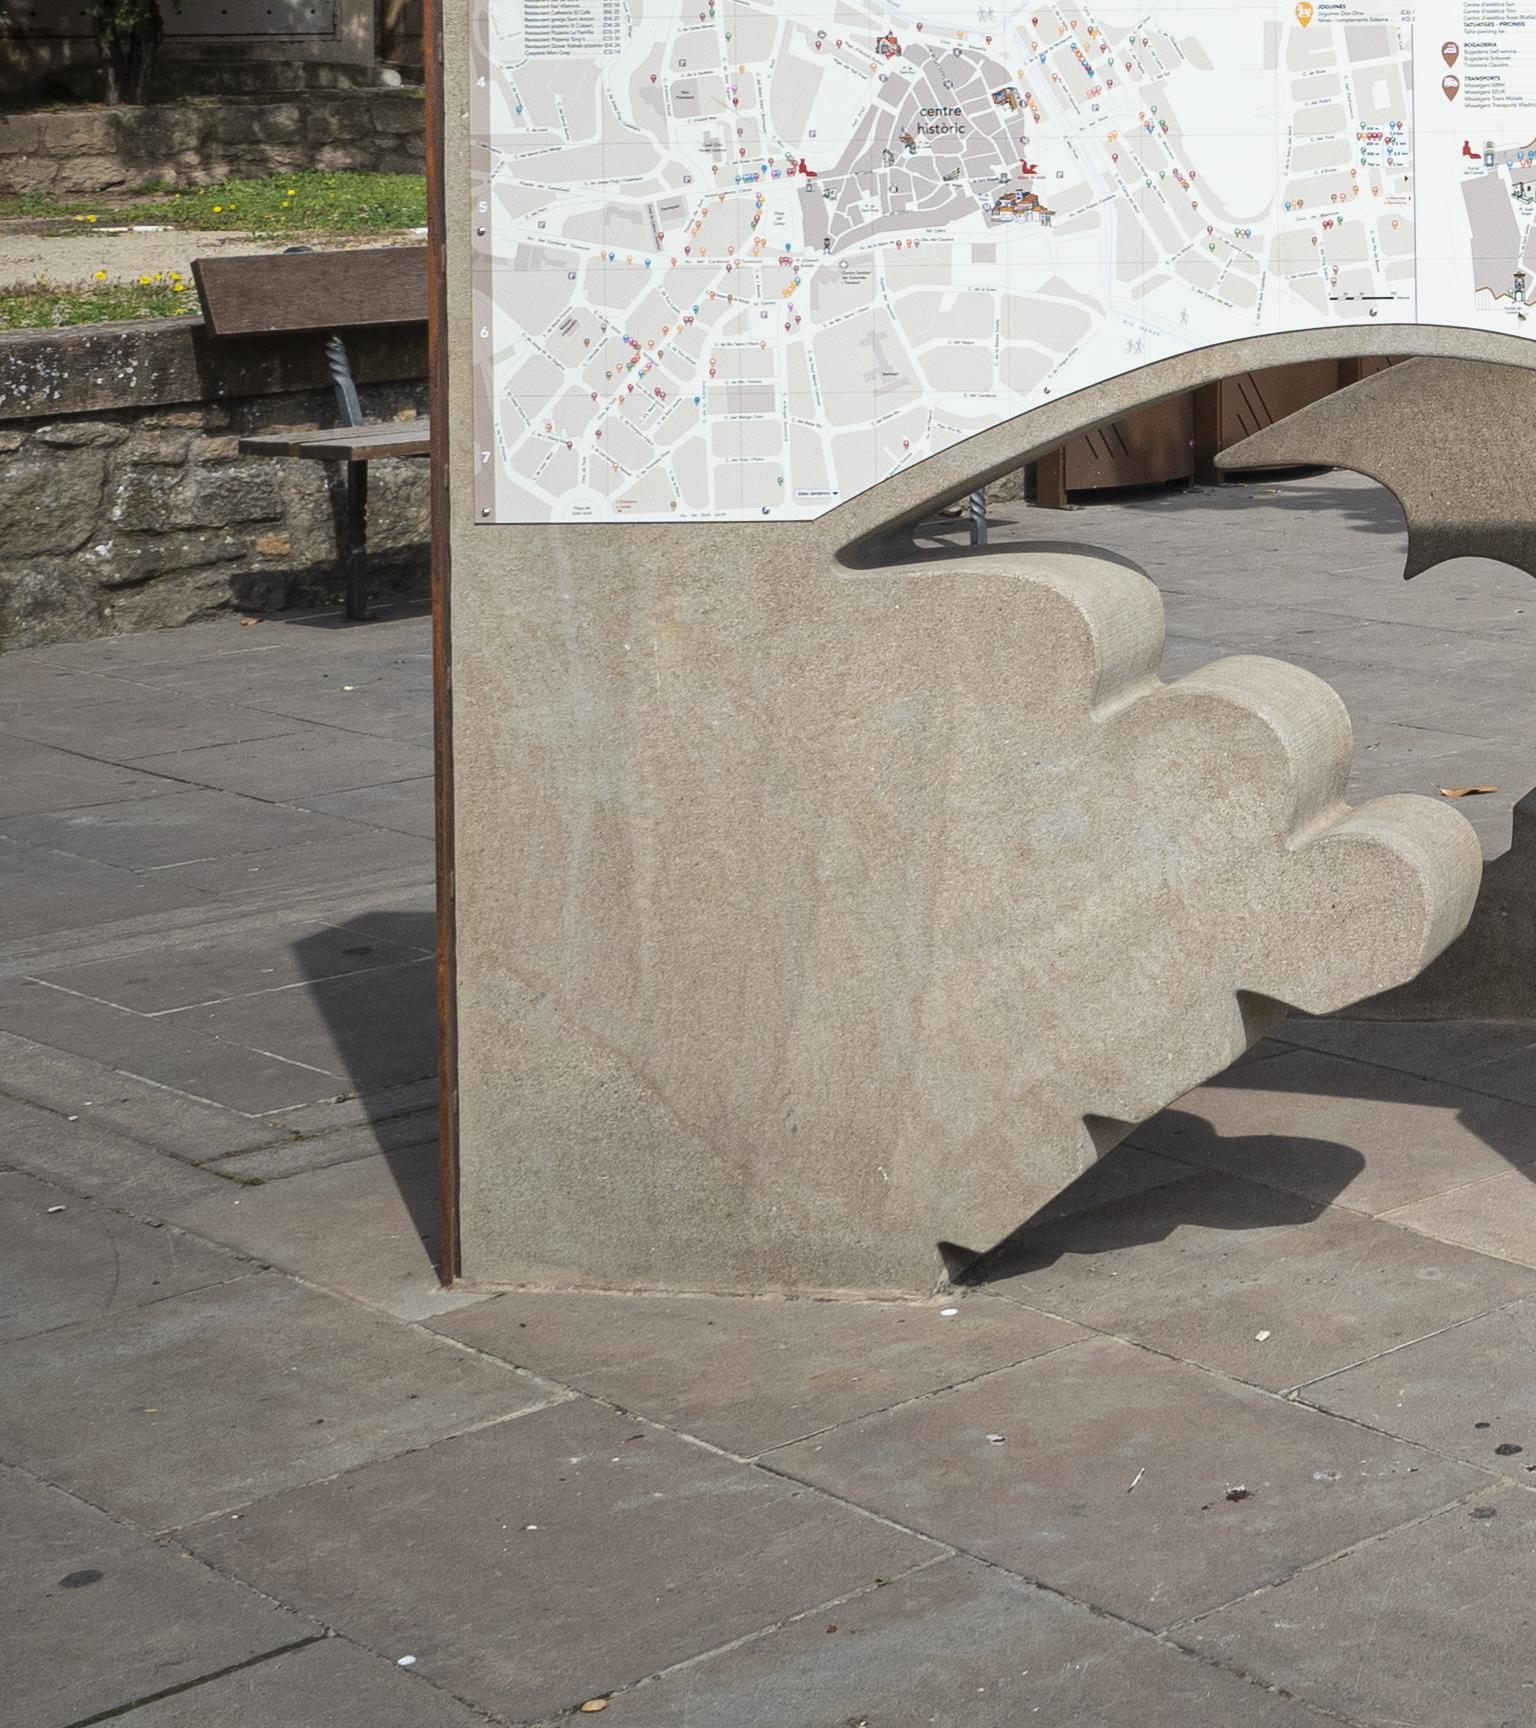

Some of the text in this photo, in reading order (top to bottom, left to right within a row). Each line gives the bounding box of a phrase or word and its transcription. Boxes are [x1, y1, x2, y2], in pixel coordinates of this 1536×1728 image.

[476, 75, 487, 88] 4
[919, 104, 963, 118] centre
[916, 120, 966, 136] històric
[479, 201, 488, 214] 5
[480, 326, 489, 338] 6
[481, 450, 491, 463] 7
